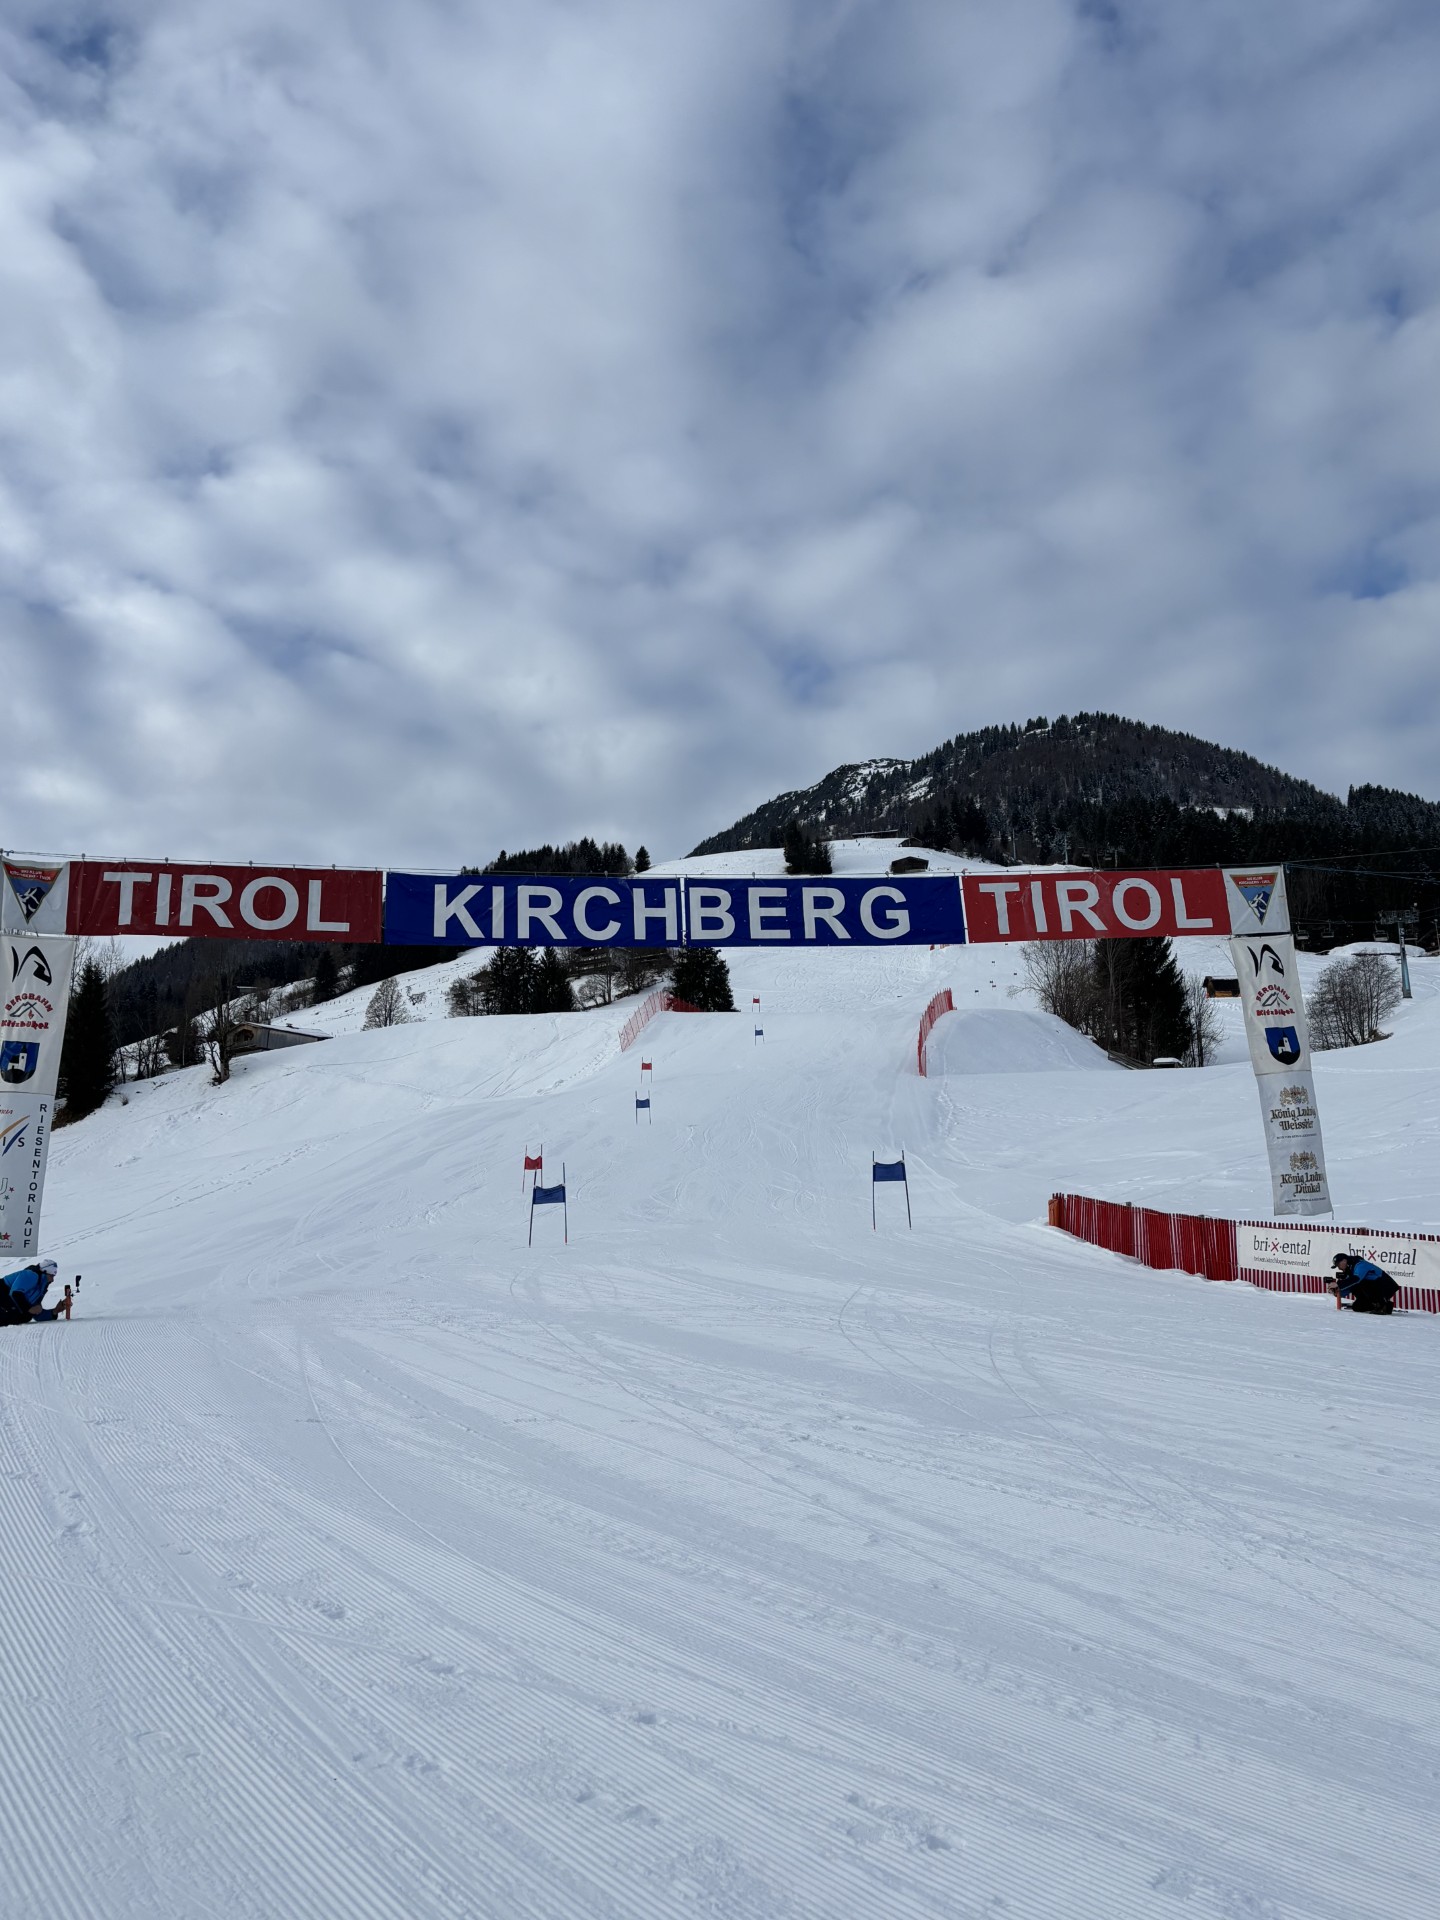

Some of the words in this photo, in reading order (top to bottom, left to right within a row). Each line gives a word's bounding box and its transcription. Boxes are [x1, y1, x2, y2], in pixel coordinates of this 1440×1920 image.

[103, 871, 350, 932] TIROL
[433, 884, 911, 941] KIRCHBERG
[979, 877, 1213, 935] TIROL
[5, 993, 54, 1012] BERGBAHN
[23, 1103, 48, 1248] RIESENTORLAUF
